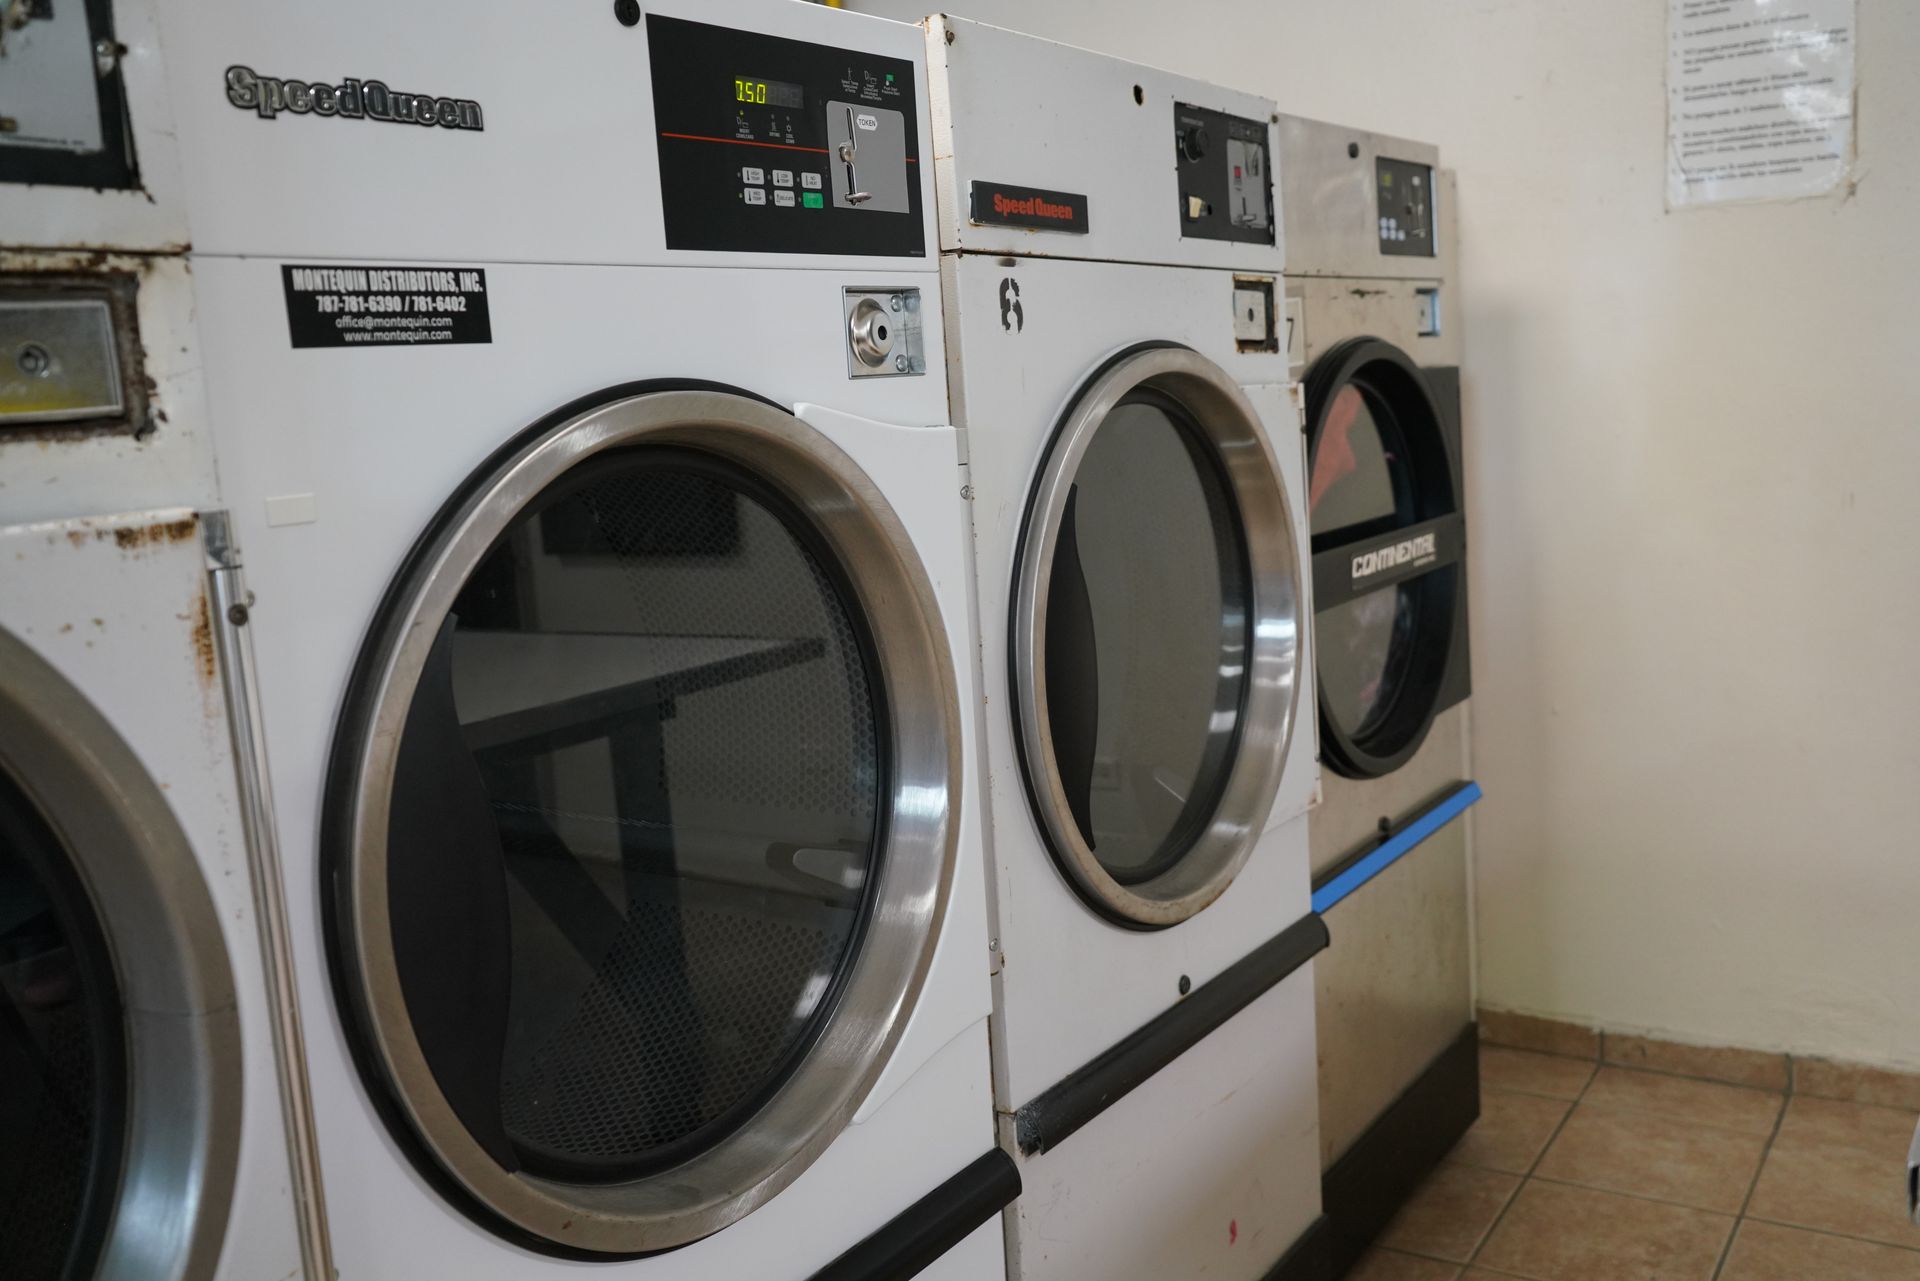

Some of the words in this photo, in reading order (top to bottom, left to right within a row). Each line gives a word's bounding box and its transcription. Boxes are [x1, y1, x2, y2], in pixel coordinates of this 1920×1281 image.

[858, 118, 876, 127] TOKEN
[993, 192, 1034, 216] Speed
[1035, 198, 1073, 219] Queen
[291, 268, 367, 293] MONTEQUIN
[368, 270, 459, 293] DISTRIBUTORS,
[460, 272, 483, 293] INC.
[315, 295, 402, 313] 787-781-6390
[404, 295, 410, 312] /
[411, 295, 467, 312] 781-6402
[335, 315, 453, 329] office@montequin.com
[343, 329, 453, 343] www.montequin.com
[1286, 318, 1294, 353] 7
